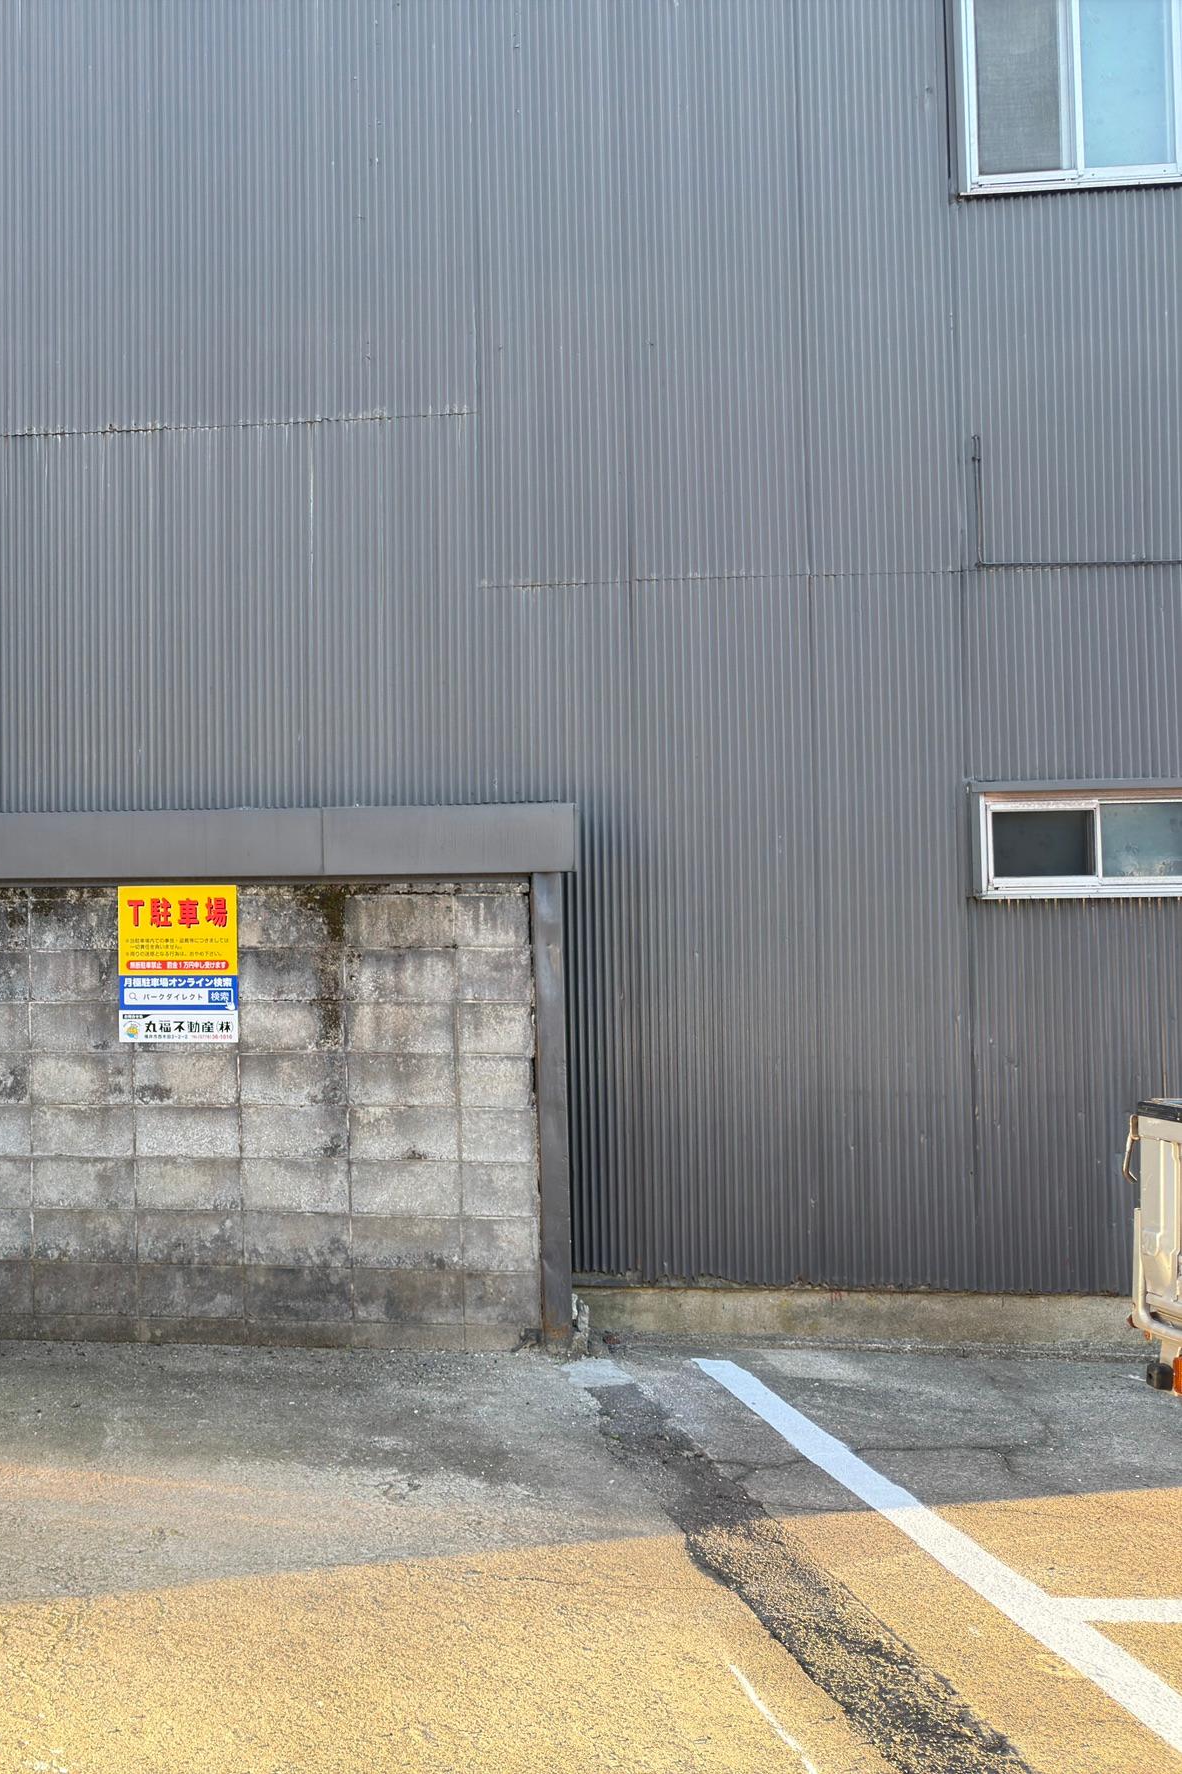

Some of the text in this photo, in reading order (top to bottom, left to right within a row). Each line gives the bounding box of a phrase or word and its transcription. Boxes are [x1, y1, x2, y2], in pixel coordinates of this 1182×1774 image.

[127, 896, 228, 928] T駐車場
[123, 977, 233, 987] 月極駐車場オンライン検索
[143, 992, 230, 1002] パークダイレクト 検索
